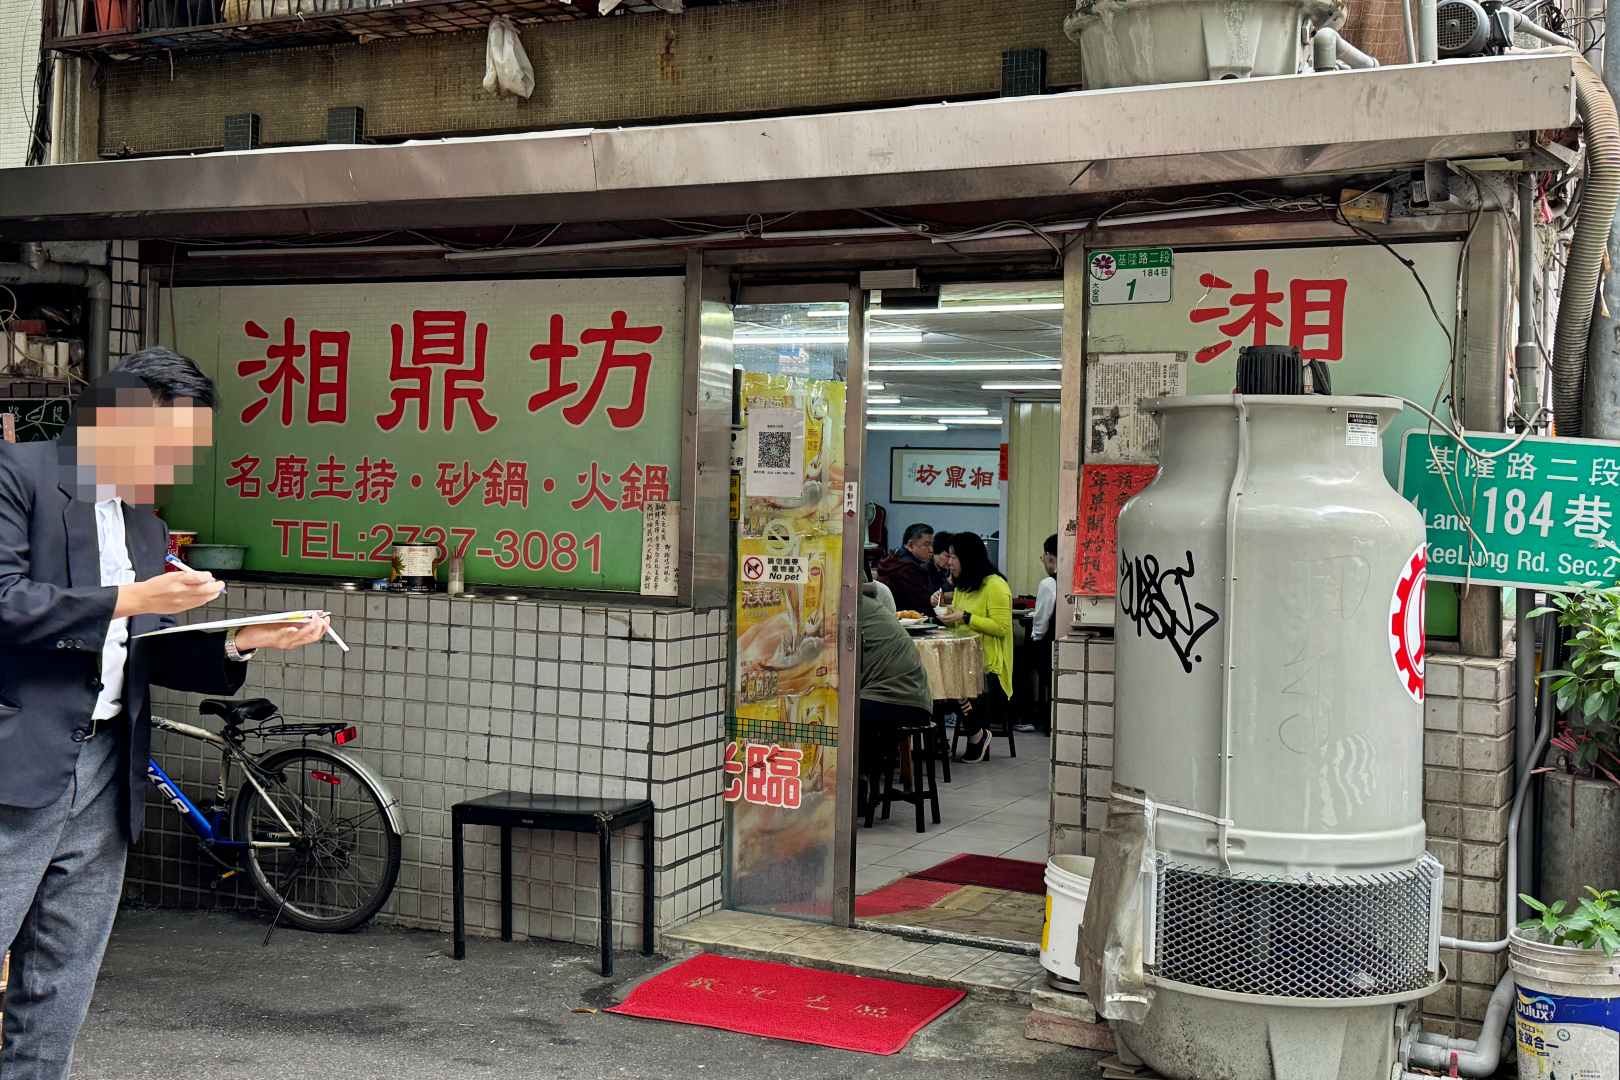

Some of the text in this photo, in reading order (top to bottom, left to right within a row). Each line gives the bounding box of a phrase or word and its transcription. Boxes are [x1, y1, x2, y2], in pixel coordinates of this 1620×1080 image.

[1117, 250, 1171, 266] 基隆路二段
[1126, 278, 1137, 301] 1
[1189, 269, 1347, 363] 湘
[236, 309, 664, 433] 湘鼎坊
[1425, 446, 1620, 487] 基隆路二段
[272, 518, 602, 574] TEL:2737-3081
[769, 572, 800, 582] No pet
[1517, 552, 1550, 573] Rd.
